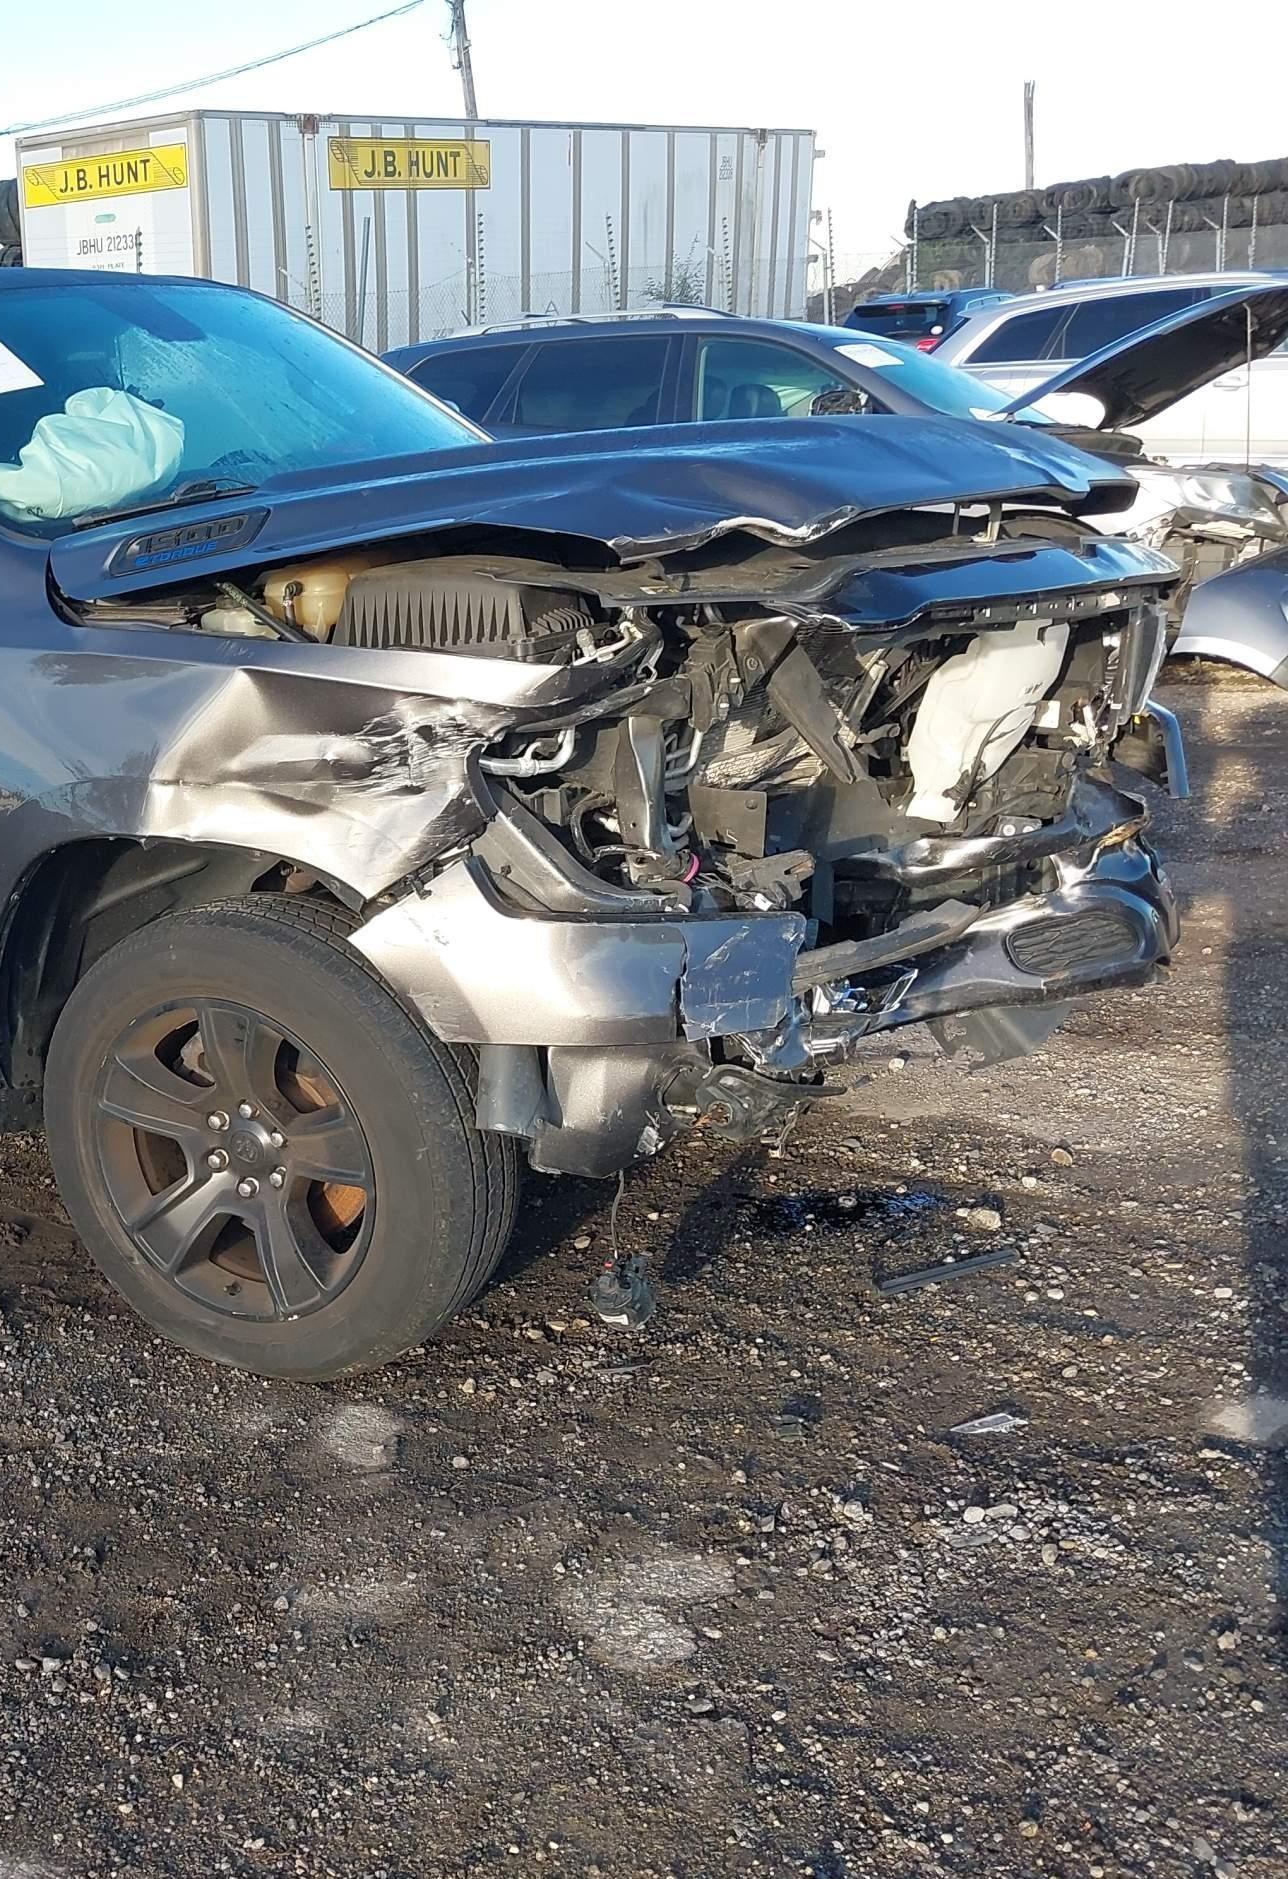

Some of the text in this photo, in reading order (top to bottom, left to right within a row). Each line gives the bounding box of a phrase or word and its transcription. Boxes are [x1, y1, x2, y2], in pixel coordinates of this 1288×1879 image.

[59, 158, 151, 193] J.B. HUNT
[363, 149, 461, 179] J.B. HUNT
[76, 236, 104, 256] JBHU
